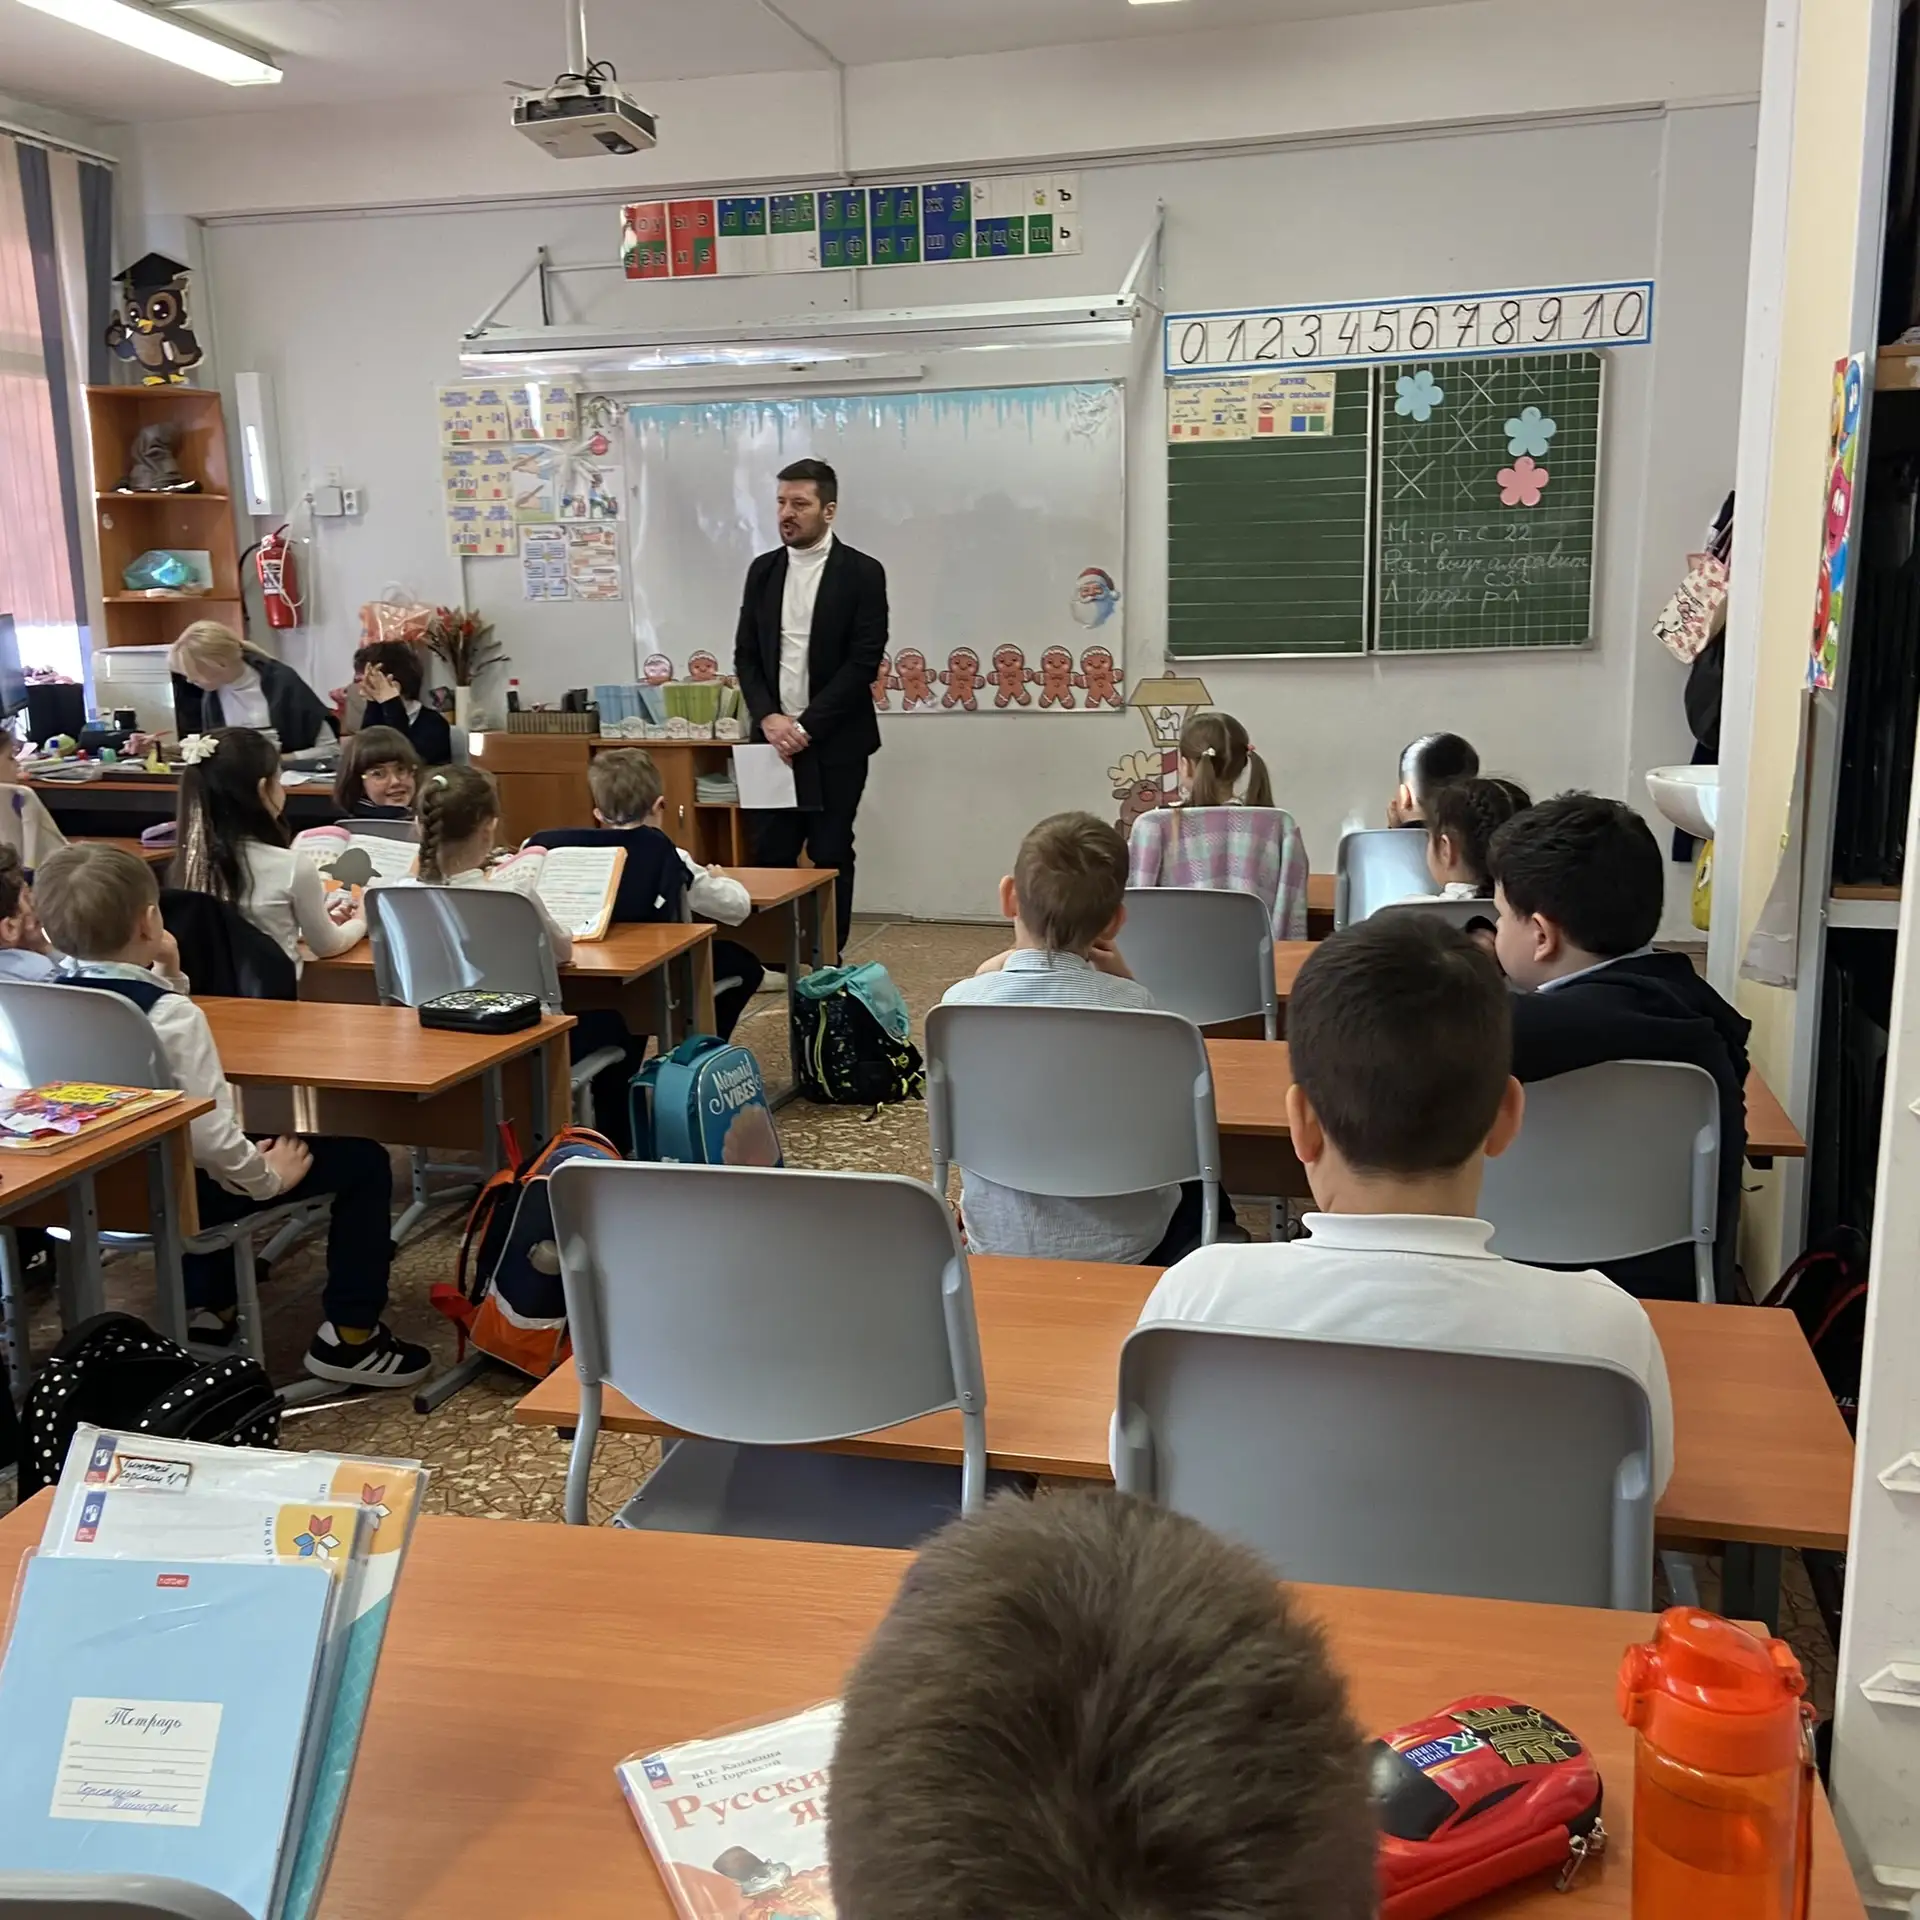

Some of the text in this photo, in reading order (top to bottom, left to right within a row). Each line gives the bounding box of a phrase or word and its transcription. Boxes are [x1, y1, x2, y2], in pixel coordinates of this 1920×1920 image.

[1180, 322, 1206, 364] 0
[1227, 319, 1245, 362] 1
[1255, 317, 1283, 360] 2
[1292, 315, 1321, 357] 3
[1338, 312, 1360, 354] 4
[1368, 310, 1399, 352] 5
[1411, 306, 1438, 349] 6
[1453, 303, 1480, 347] 7
[1492, 301, 1520, 344] 8
[1533, 298, 1561, 341] 9
[709, 1053, 762, 1115] Mermaid
[723, 1078, 757, 1109] VIBES
[105, 1706, 182, 1736] Тетрадь
[660, 1768, 831, 1831] Русски
